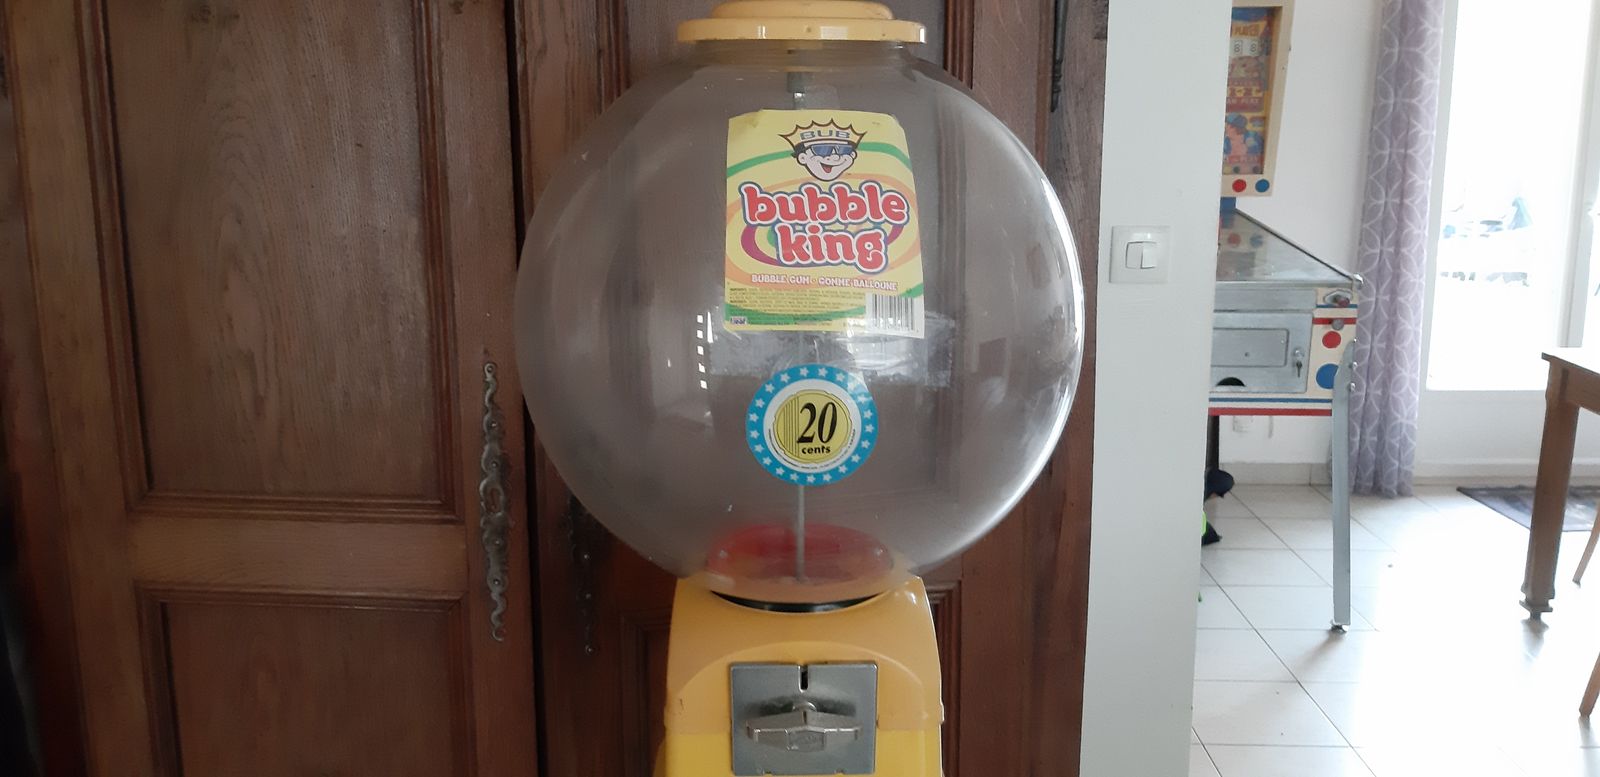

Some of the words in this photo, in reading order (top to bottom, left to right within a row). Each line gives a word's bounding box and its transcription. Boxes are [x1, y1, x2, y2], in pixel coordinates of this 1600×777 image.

[800, 130, 850, 140] BUB
[741, 181, 908, 224] bubble
[775, 223, 887, 272] king
[751, 274, 786, 283] BUBBLE
[789, 275, 810, 284] GUM
[818, 277, 850, 287] GOMME
[851, 279, 898, 291] BALLOUNE
[796, 402, 838, 444] 20
[802, 446, 831, 455] cents
